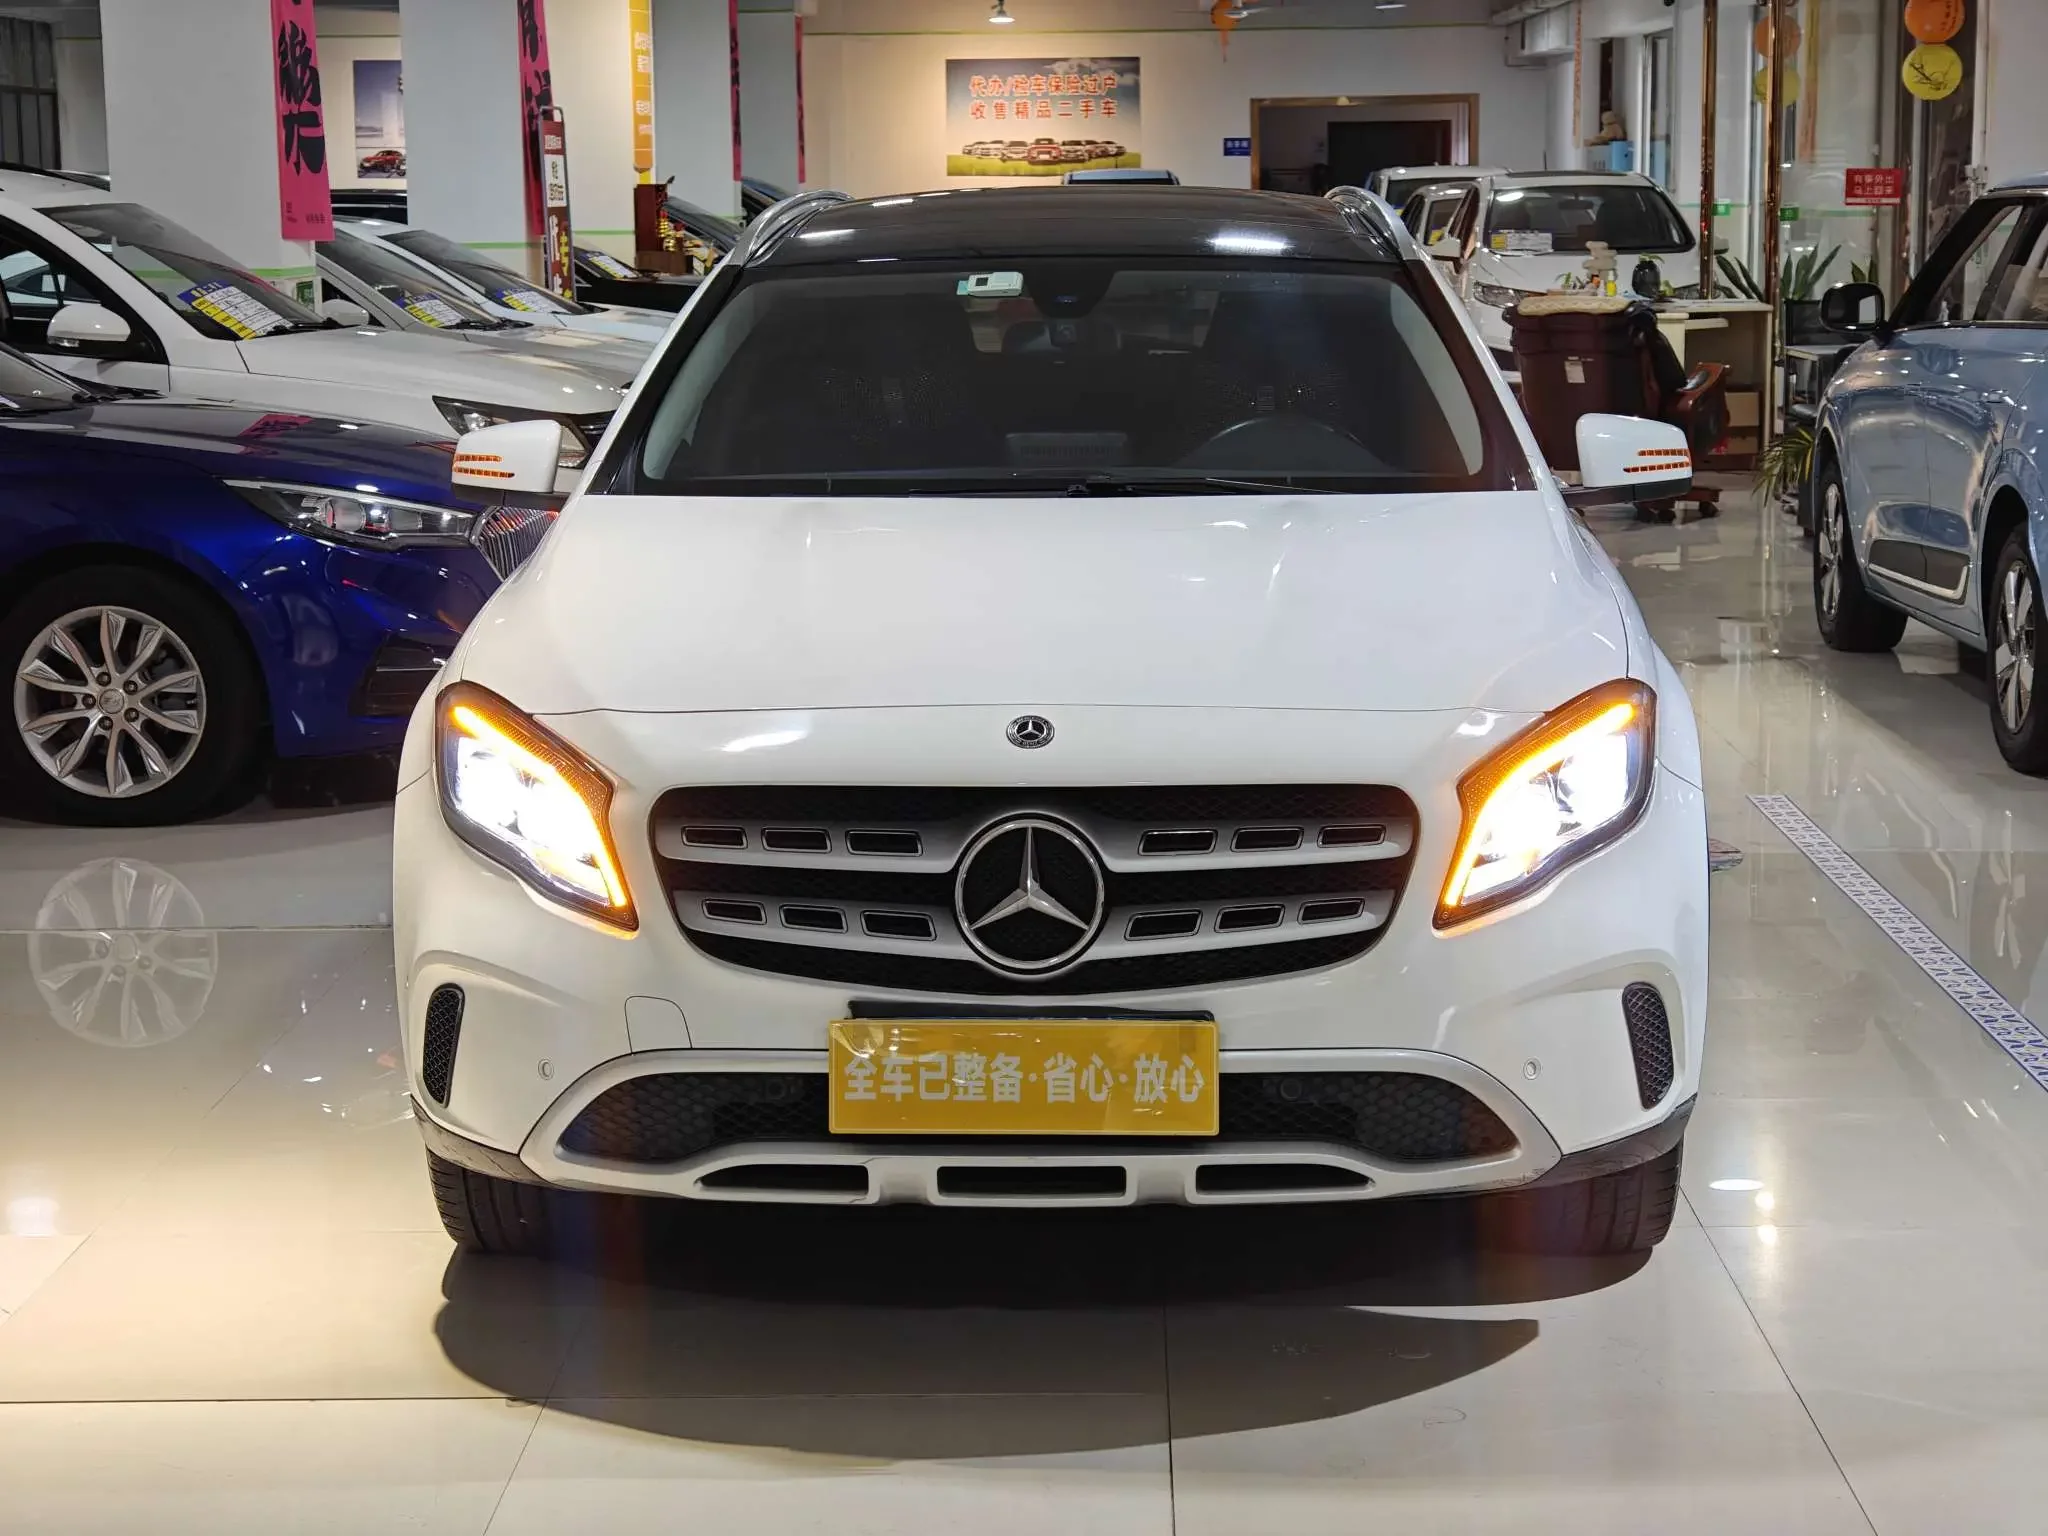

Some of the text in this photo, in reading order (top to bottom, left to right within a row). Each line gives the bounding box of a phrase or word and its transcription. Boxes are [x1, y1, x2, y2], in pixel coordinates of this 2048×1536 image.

[969, 98, 1118, 120] 收售精品二手车
[843, 1052, 1206, 1104] 全车已整备·省心·放心
